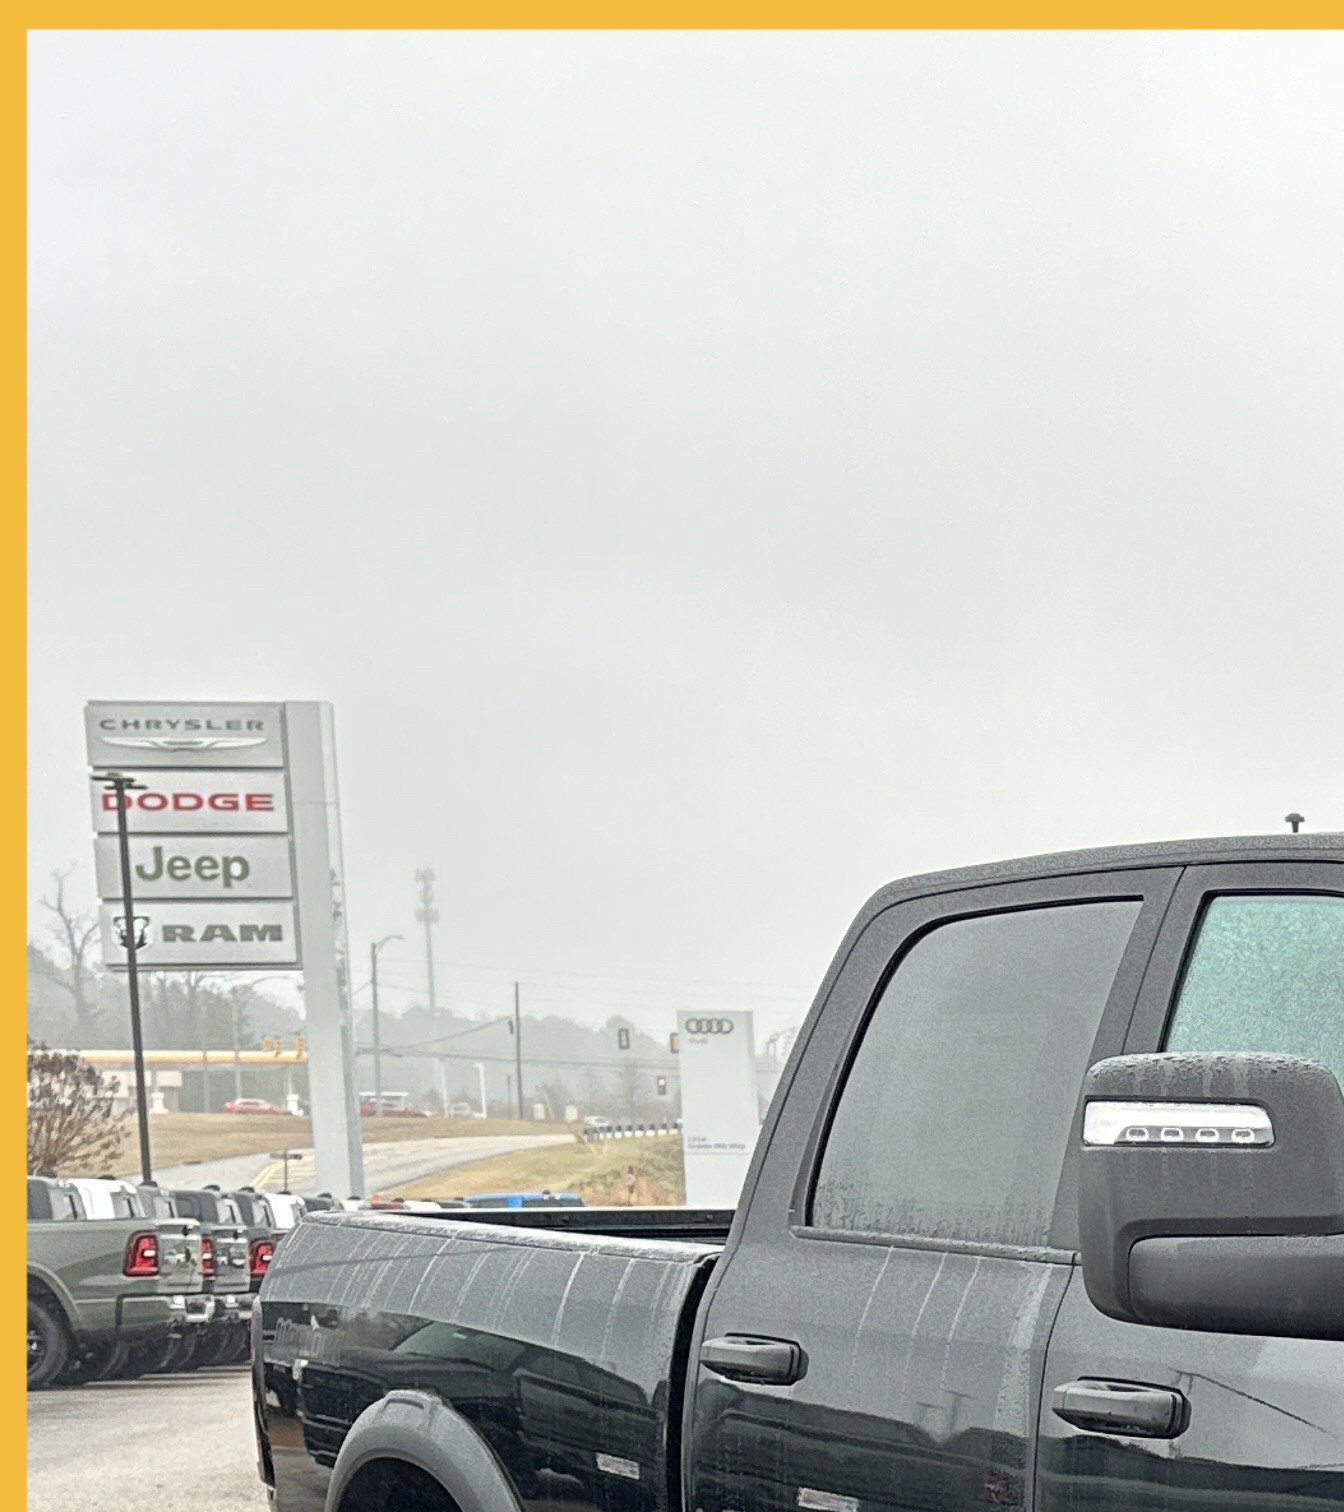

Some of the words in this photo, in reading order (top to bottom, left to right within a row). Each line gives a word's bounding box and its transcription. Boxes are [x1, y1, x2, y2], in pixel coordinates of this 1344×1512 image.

[99, 718, 265, 731] CHRYSLER
[101, 792, 275, 812] DODGE
[135, 846, 250, 889] Jeep
[162, 923, 284, 943] RAM
